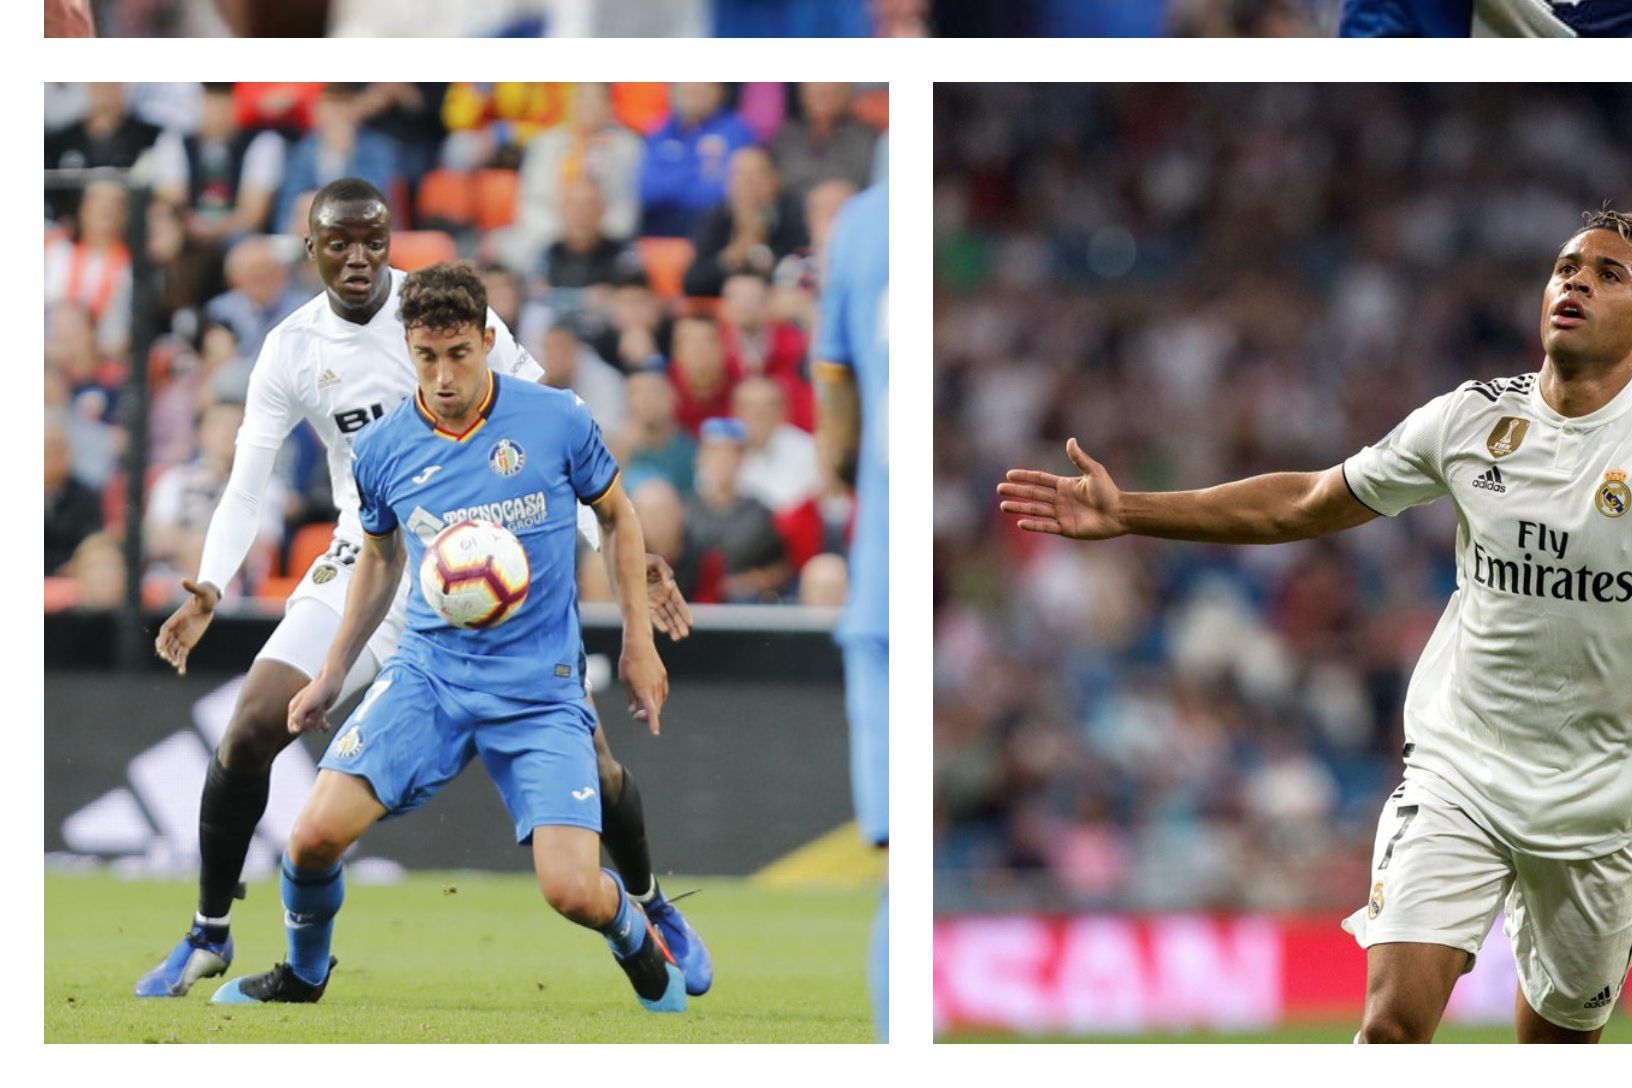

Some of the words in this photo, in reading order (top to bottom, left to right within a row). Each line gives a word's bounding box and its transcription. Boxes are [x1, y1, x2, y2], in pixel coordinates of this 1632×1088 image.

[1472, 479, 1507, 493] adidas
[1518, 520, 1568, 559] Fly
[1378, 805, 1419, 870] 7
